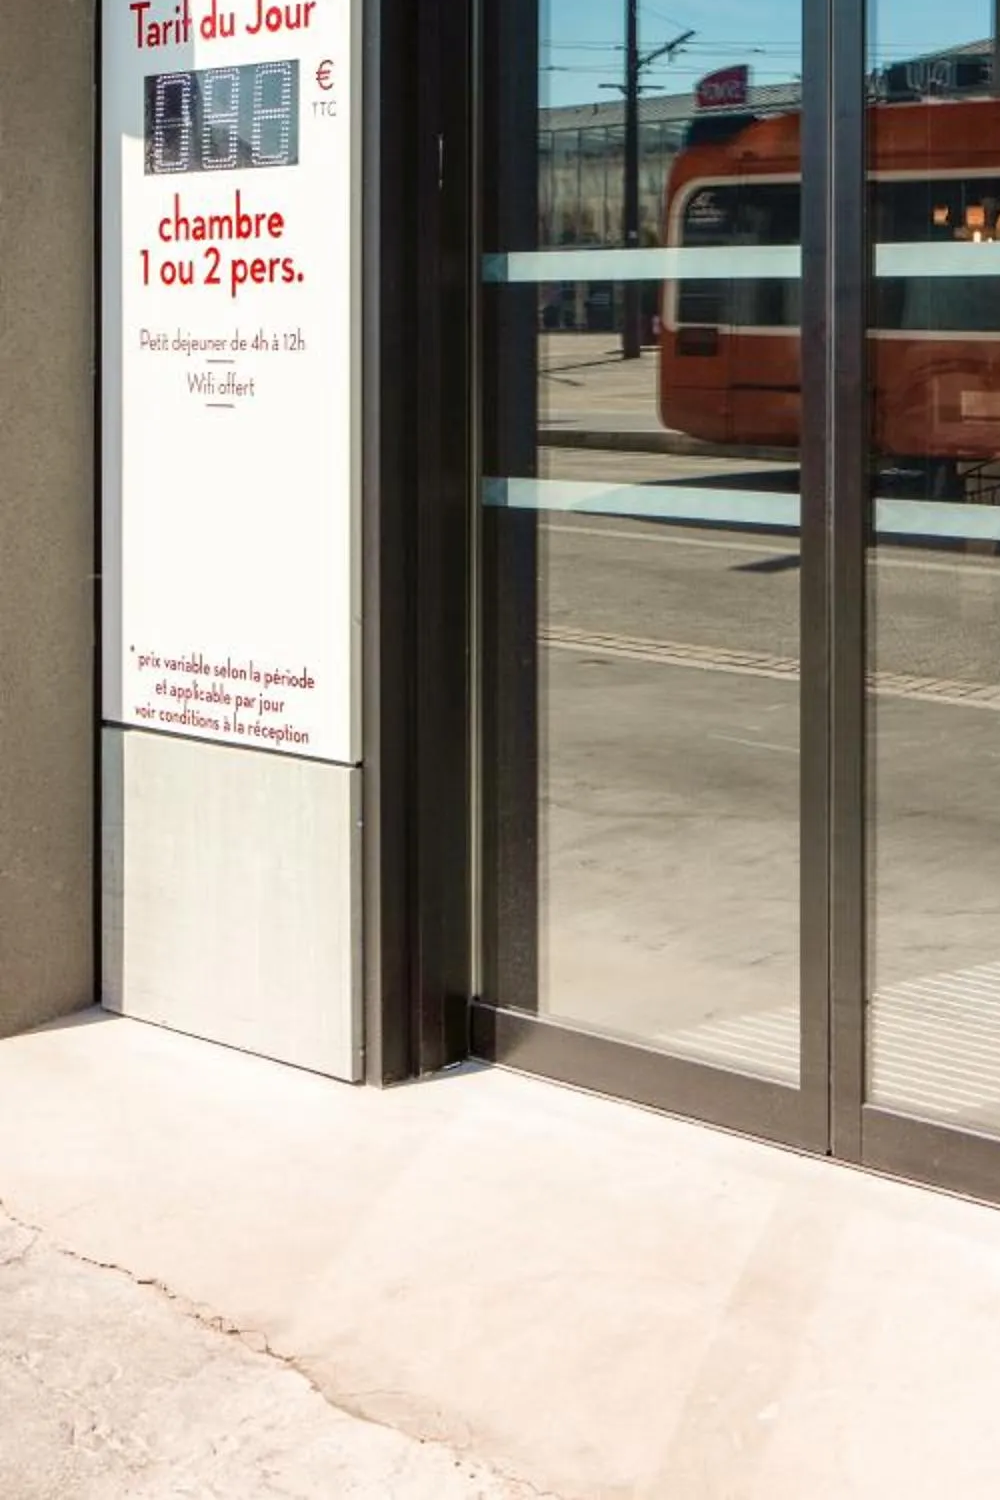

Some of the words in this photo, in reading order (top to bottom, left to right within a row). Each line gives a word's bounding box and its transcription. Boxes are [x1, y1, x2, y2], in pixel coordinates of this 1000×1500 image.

[315, 59, 335, 91] €
[312, 100, 337, 118] TTC
[158, 189, 285, 243] chambre
[139, 248, 151, 287] 1
[159, 260, 194, 286] ou
[203, 247, 222, 285] 2
[231, 252, 305, 298] pers.
[139, 328, 168, 351] Petit
[231, 327, 248, 351] de
[251, 327, 269, 351] 4h
[284, 327, 306, 351] 12h
[217, 371, 255, 397] offert
[164, 652, 211, 676] variable
[213, 657, 247, 681] selon
[249, 659, 261, 682] la
[263, 666, 316, 690] période
[155, 678, 167, 695] et
[169, 680, 232, 705] applicable
[234, 695, 256, 713] par
[258, 692, 285, 716] jour
[159, 699, 220, 731] conditions
[233, 711, 245, 735] la
[248, 719, 310, 746] réception
